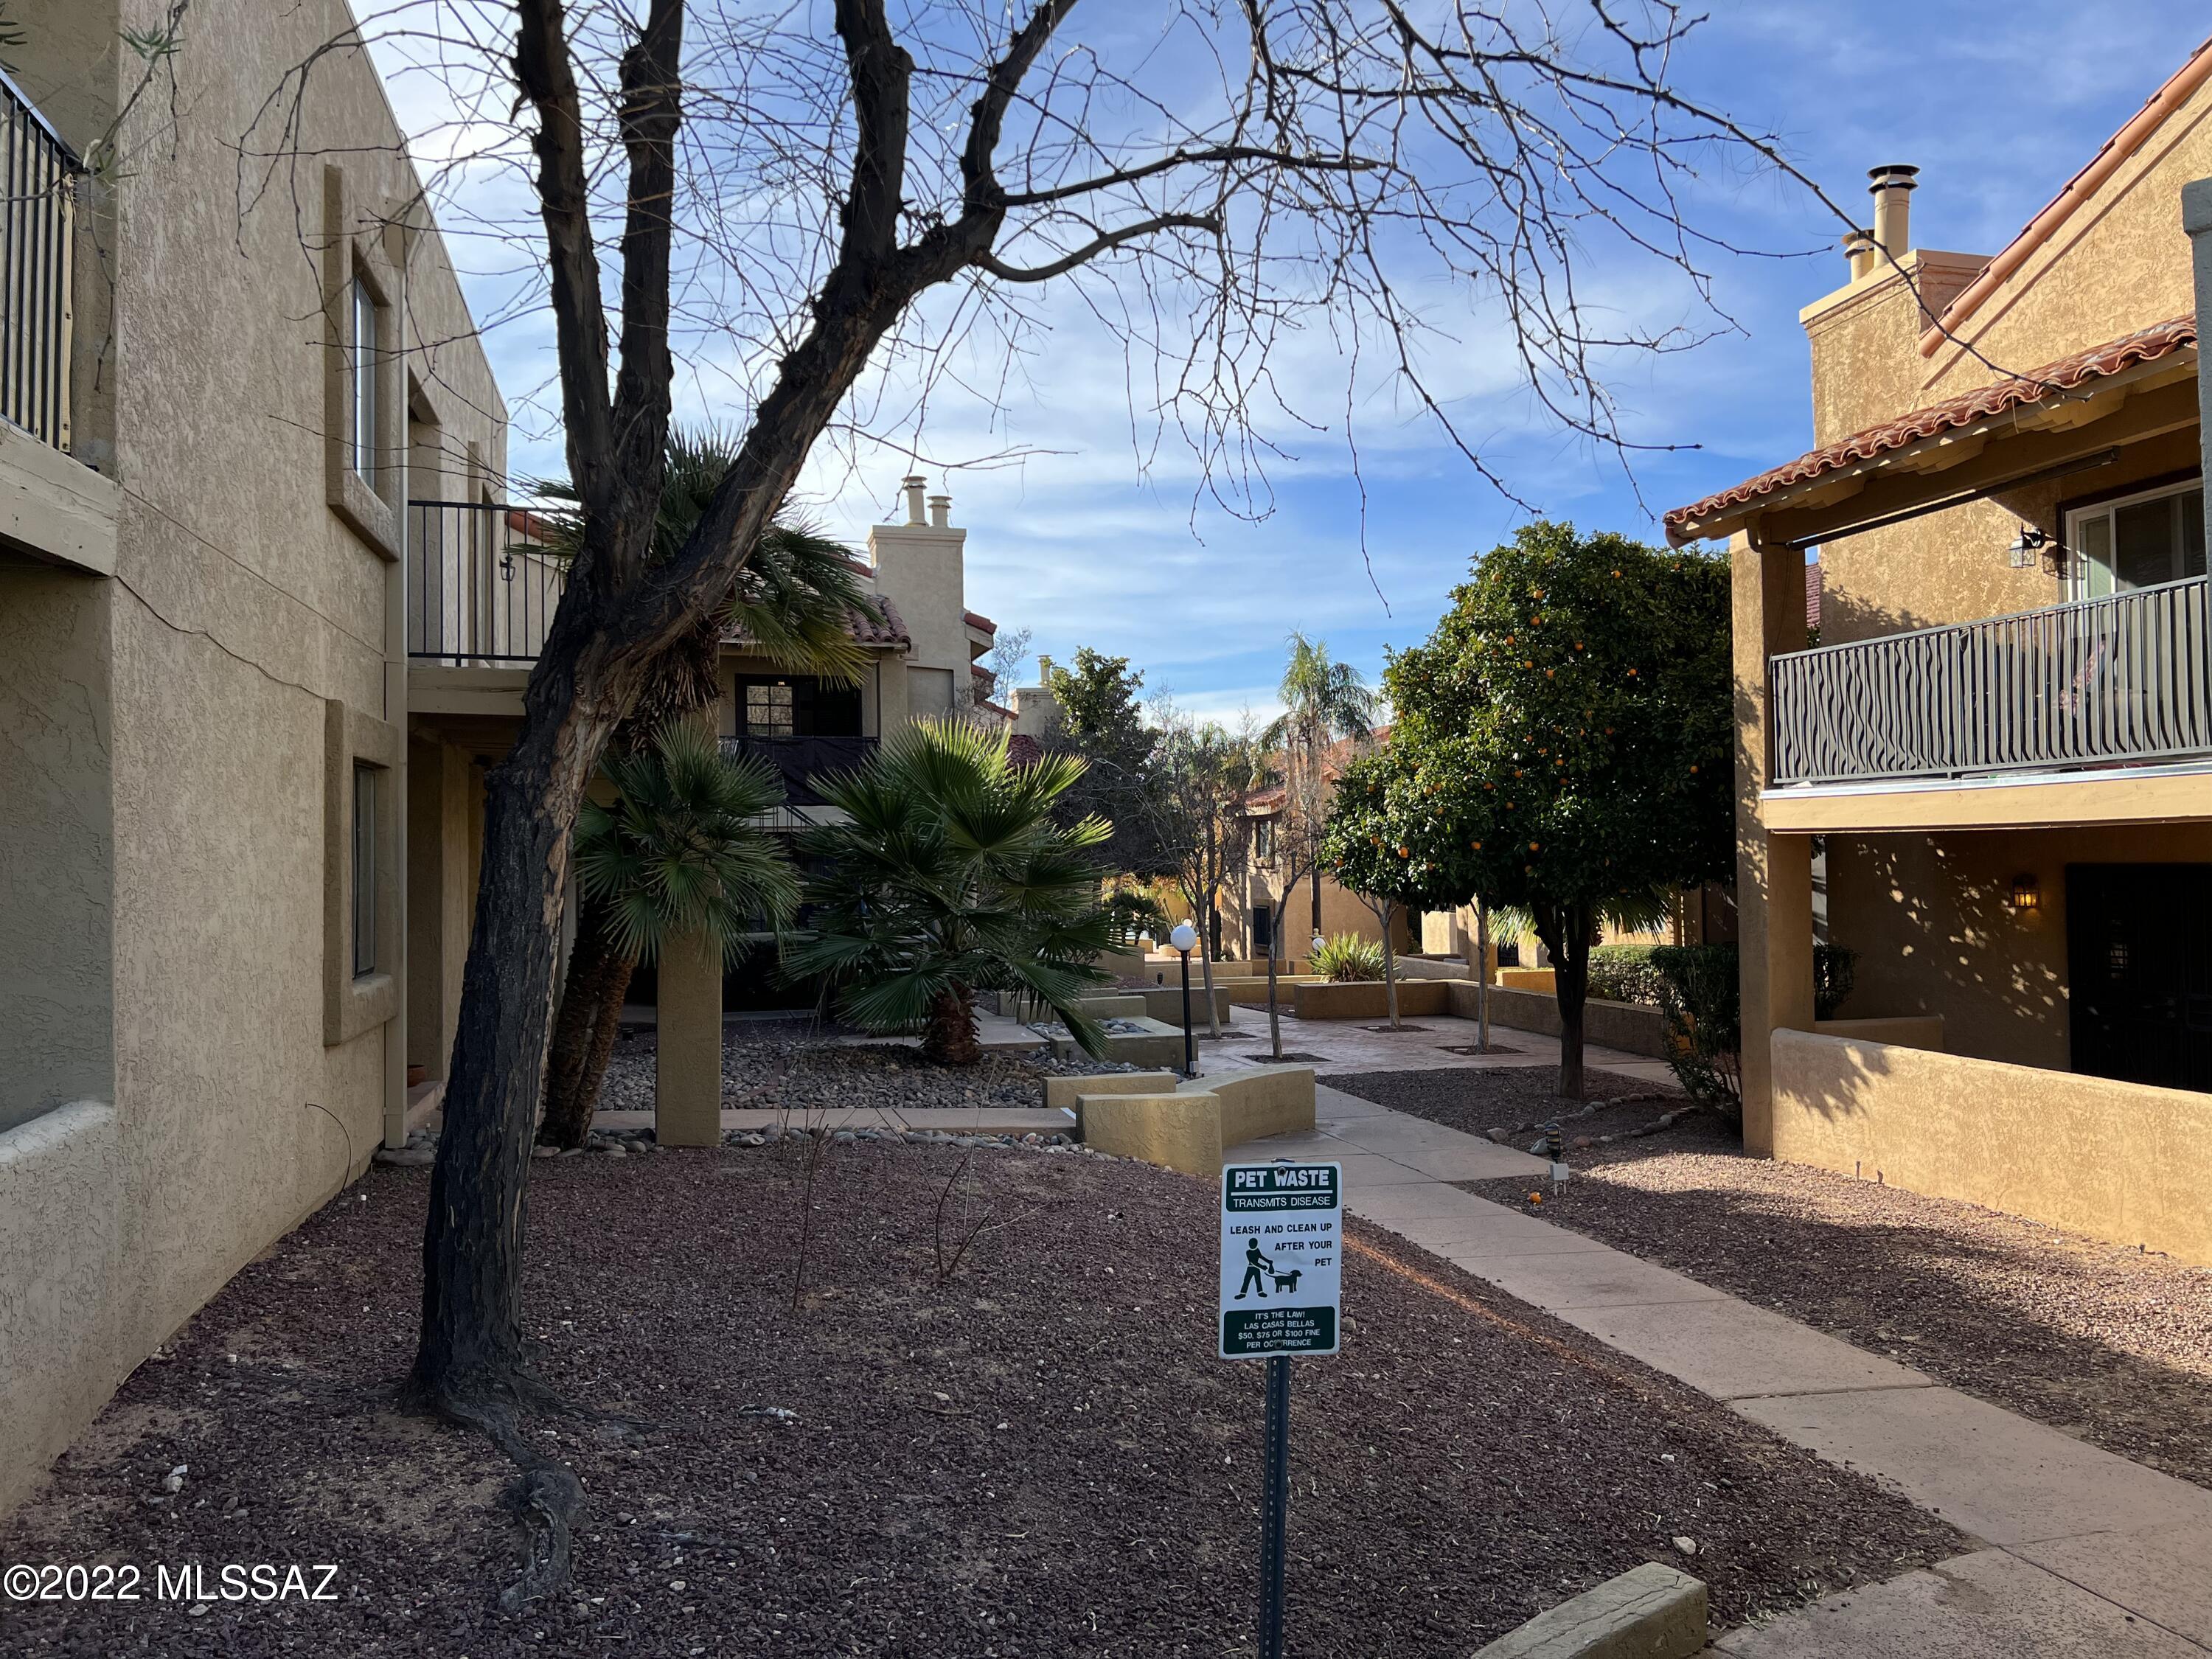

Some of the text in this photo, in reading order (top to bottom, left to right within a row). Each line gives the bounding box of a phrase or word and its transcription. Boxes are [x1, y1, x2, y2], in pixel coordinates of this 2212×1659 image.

[1234, 1169, 1329, 1188] PET WASTE
[1233, 1196, 1331, 1208] TRANSMITS DISEASE
[1230, 1222, 1332, 1234] LEASH AND CLEAN UP
[1274, 1240, 1332, 1251] AFTER YOUR
[1315, 1258, 1332, 1267] PET
[1287, 1310, 1305, 1318] LAW!
[1262, 1321, 1284, 1329] CASAS
[1287, 1319, 1315, 1328] BELLAS
[1263, 1338, 1312, 1348] OCRRENCE
